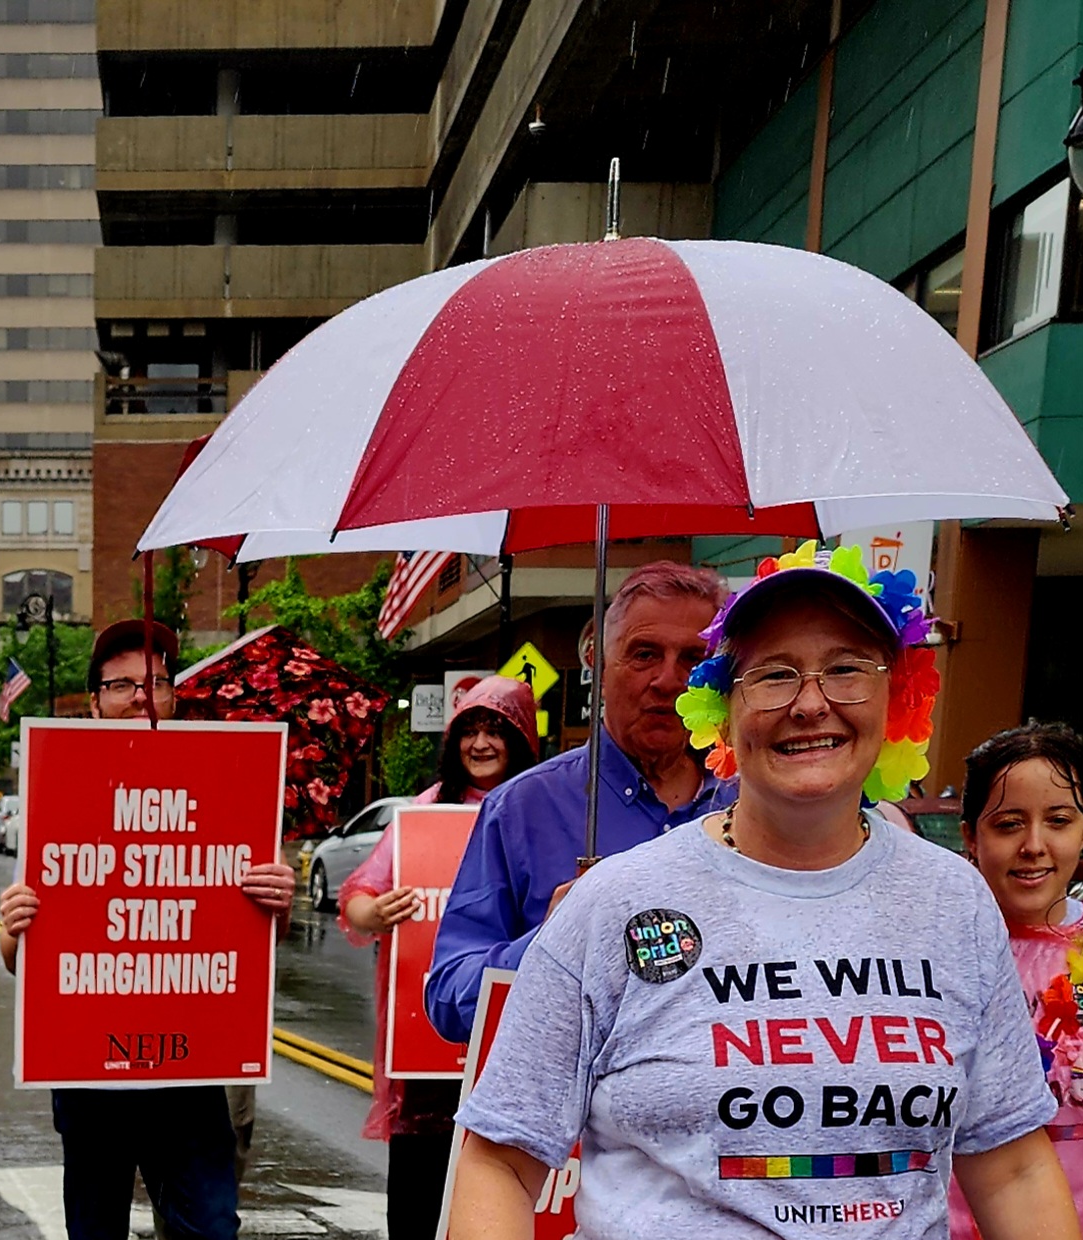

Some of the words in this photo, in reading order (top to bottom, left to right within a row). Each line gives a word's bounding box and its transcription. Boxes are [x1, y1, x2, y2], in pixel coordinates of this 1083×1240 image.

[113, 788, 198, 832] MGM:
[41, 843, 116, 887] STOP
[123, 843, 252, 887] STALLING
[107, 898, 197, 941] START
[629, 917, 688, 942] union
[636, 933, 695, 968] pride
[58, 950, 238, 996] BARGAINING!
[702, 961, 803, 1004] WE
[813, 957, 943, 1001] WILL
[106, 1032, 190, 1067] NEJB
[711, 1015, 954, 1068] NEVER
[718, 1086, 805, 1130] GO
[821, 1084, 958, 1128] BACK
[774, 1199, 905, 1224] UNITEHERE!
